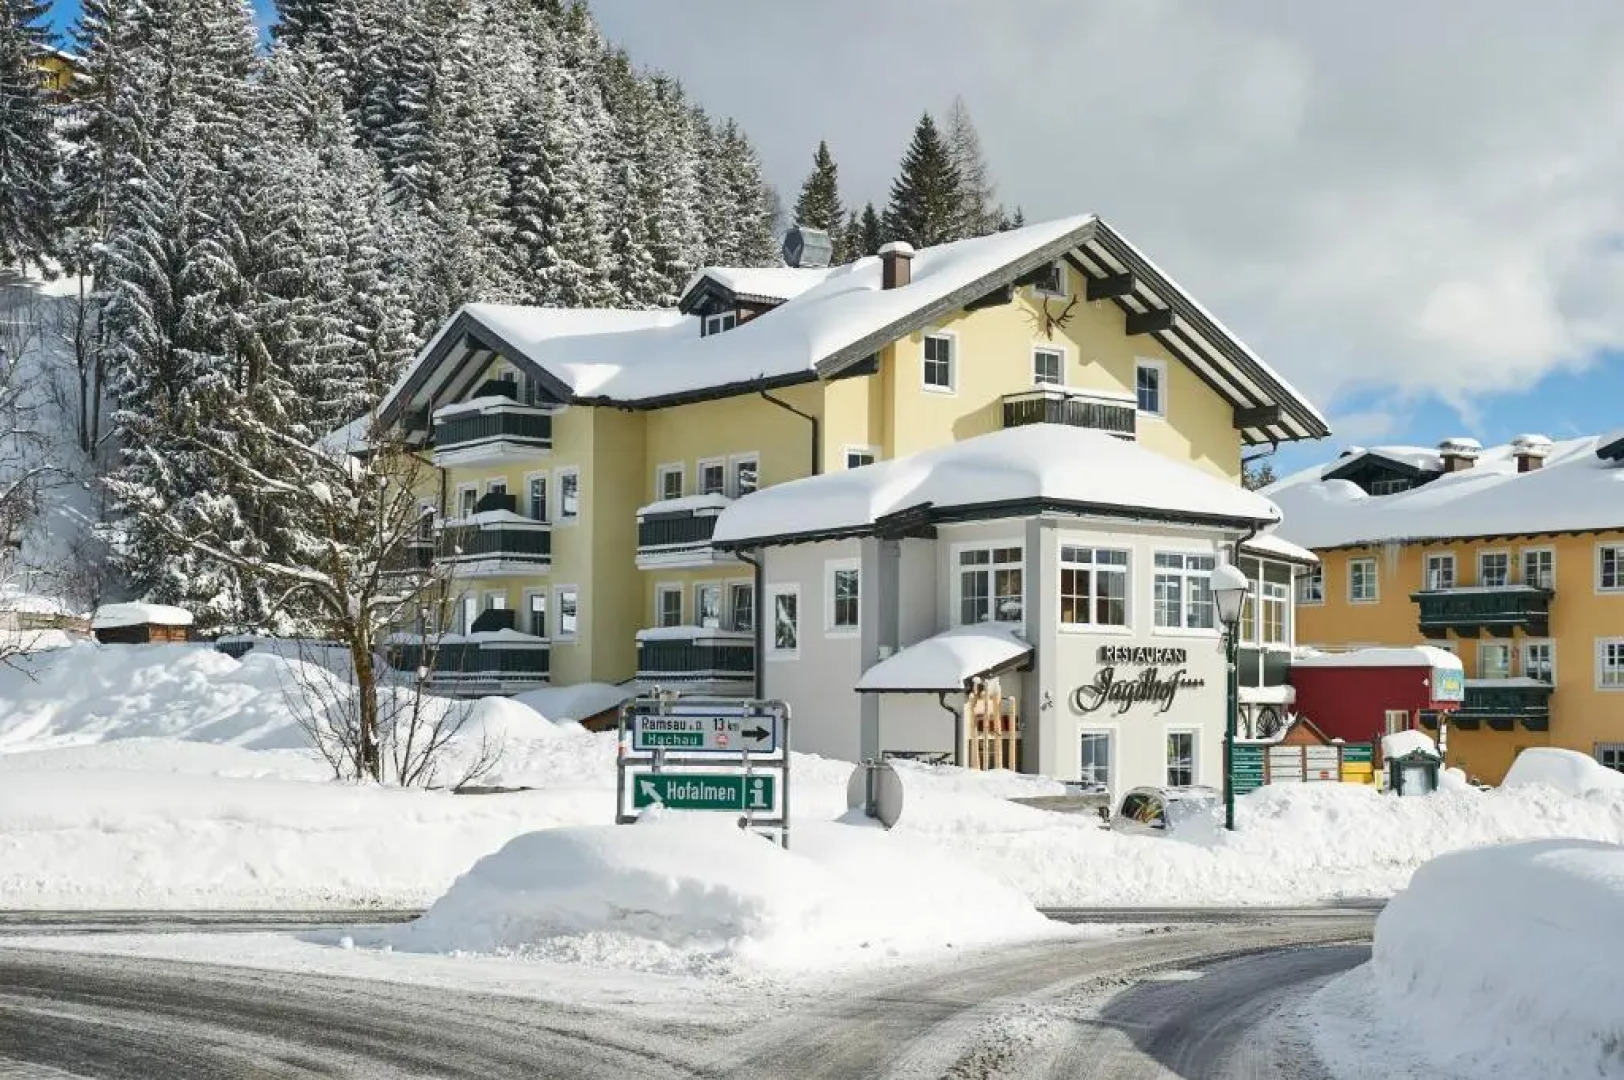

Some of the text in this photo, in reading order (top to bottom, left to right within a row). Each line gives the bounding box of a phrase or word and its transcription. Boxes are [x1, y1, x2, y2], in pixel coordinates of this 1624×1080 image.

[1072, 667, 1187, 714] Jagdhof
[641, 716, 686, 731] Ramsau
[713, 717, 725, 731] 13
[648, 733, 698, 746] Hachau
[666, 779, 736, 801] Hofalmen
